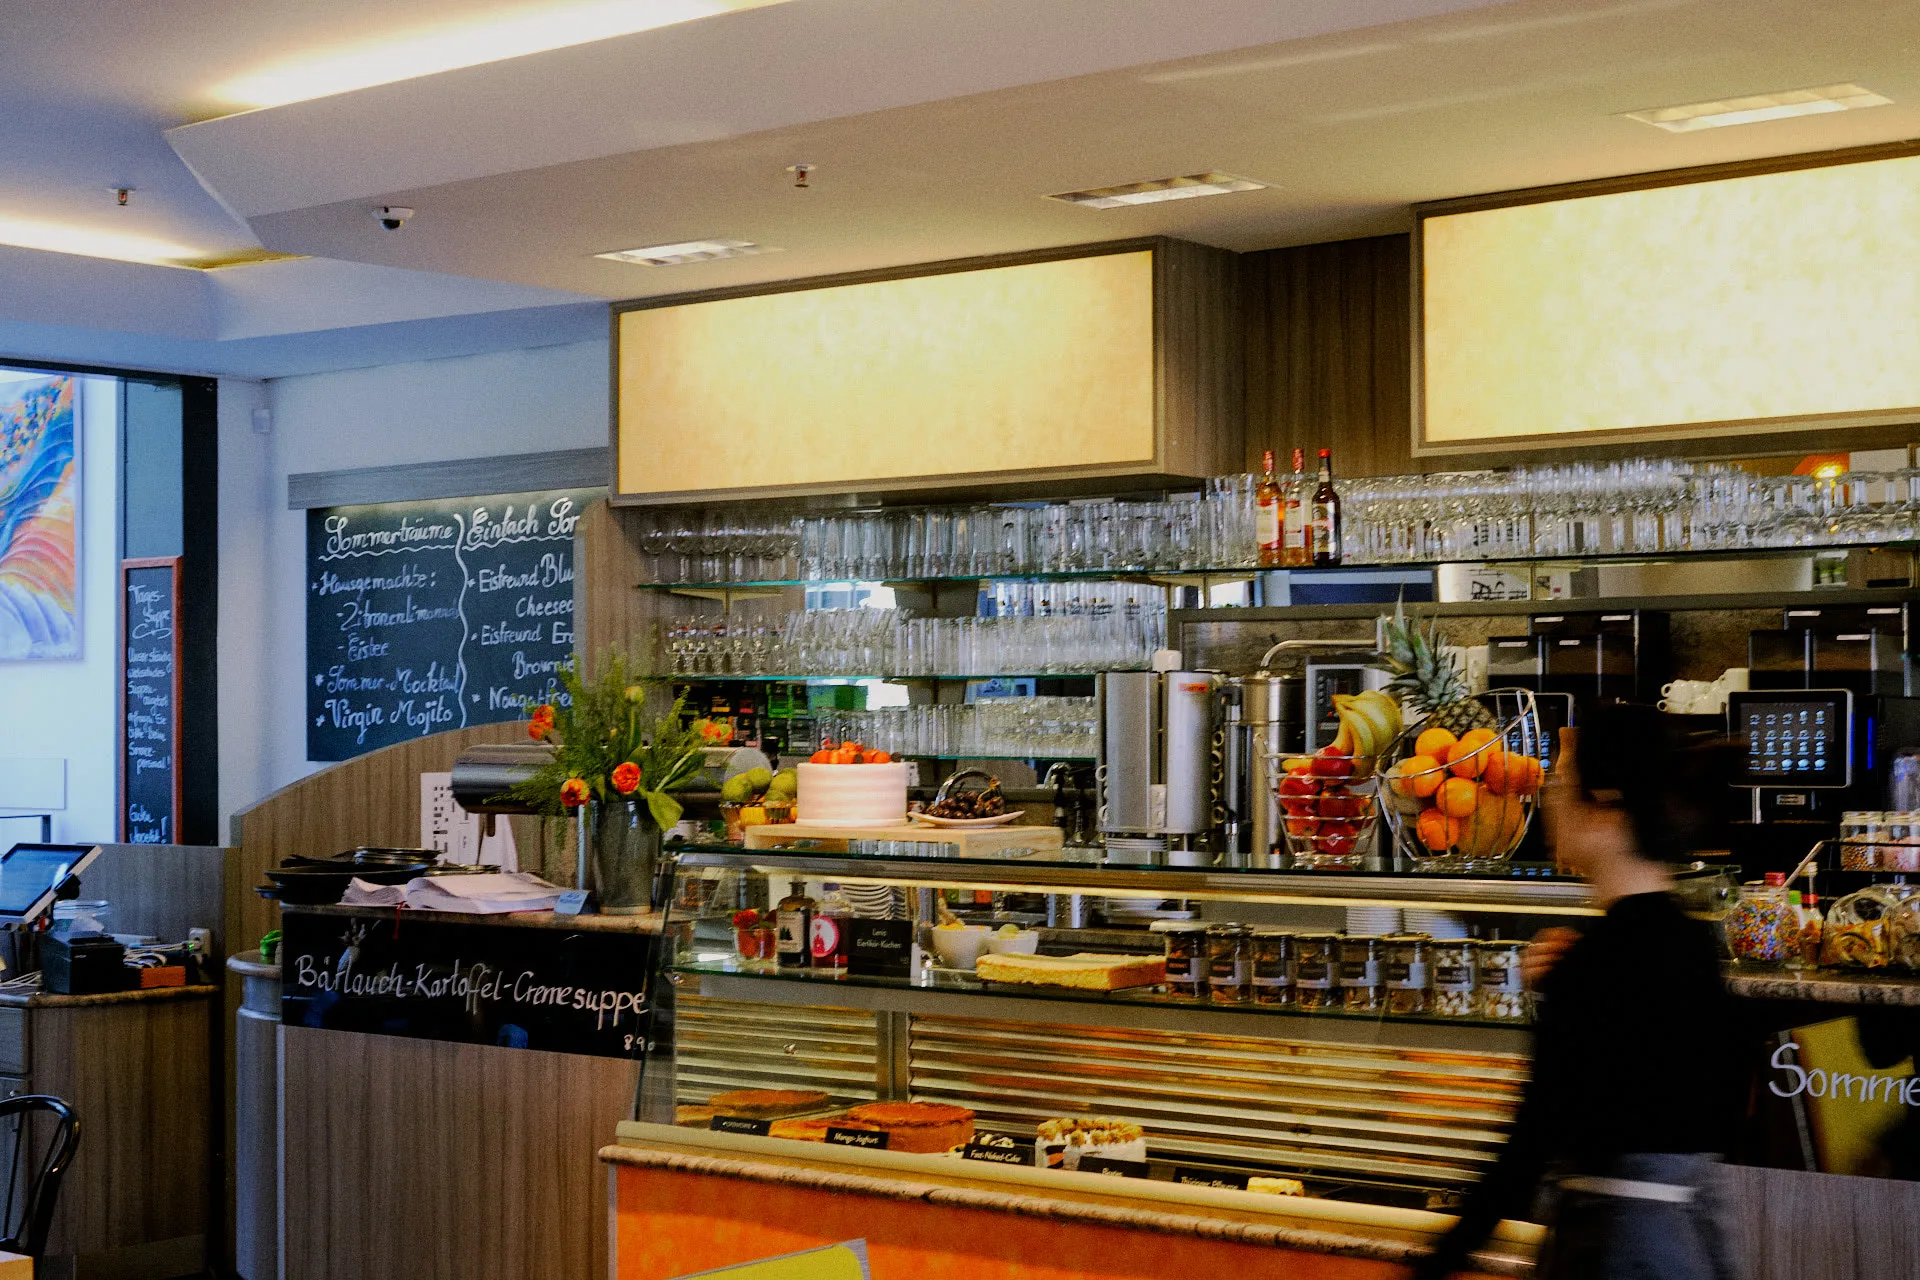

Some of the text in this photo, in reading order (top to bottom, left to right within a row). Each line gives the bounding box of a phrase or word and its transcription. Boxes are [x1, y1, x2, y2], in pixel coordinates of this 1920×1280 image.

[325, 515, 453, 555] Sommerträume
[467, 505, 539, 546] Einfach
[478, 563, 540, 593] Eisfreund
[347, 631, 390, 662] Eistee
[480, 620, 542, 646] Eisfreund
[325, 694, 453, 745] Virgin Mojito
